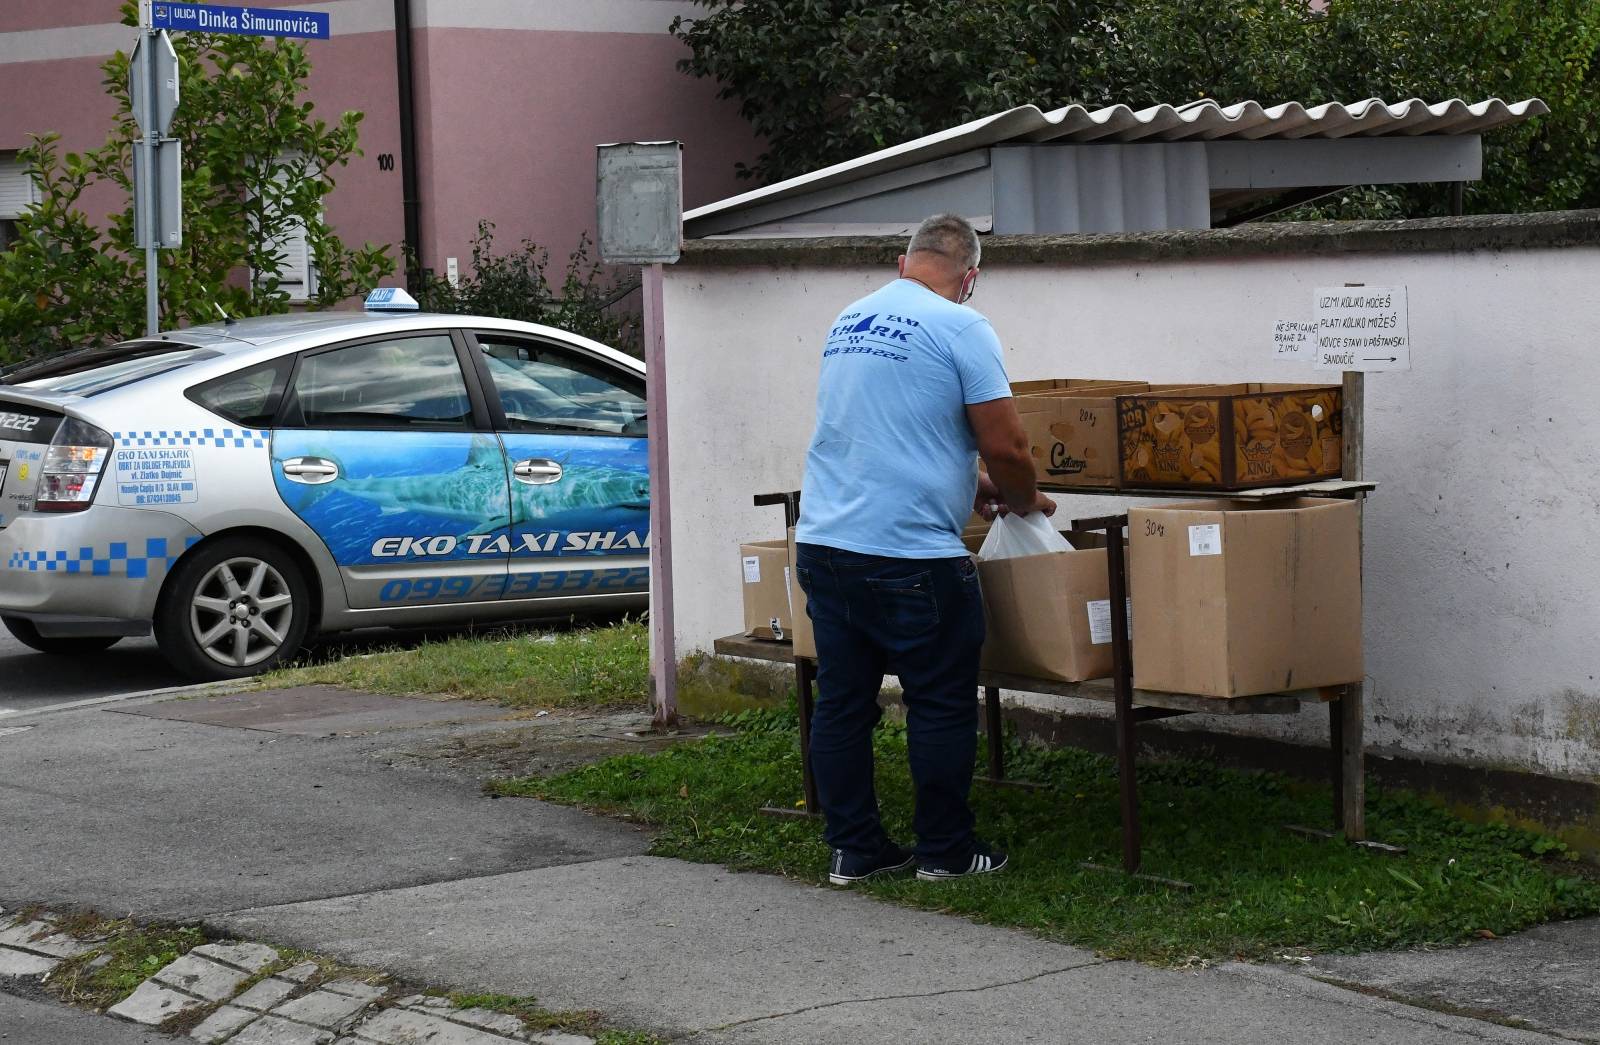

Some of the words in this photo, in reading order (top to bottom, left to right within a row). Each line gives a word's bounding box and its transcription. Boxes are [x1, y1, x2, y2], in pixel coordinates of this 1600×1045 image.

[174, 7, 197, 20] ULICA
[199, 9, 238, 29] Dinka
[241, 8, 319, 34] Šimunovića
[377, 153, 395, 171] 100
[369, 288, 390, 301] TAXI
[1319, 296, 1340, 308] UZMI
[1341, 296, 1364, 308] KOLIKO
[886, 314, 919, 327] TAXI
[1320, 318, 1341, 328] PLATI
[1342, 316, 1366, 328] KOLIKO
[1367, 312, 1397, 328] MOŽEŠ
[1297, 333, 1306, 342] ZA
[1319, 336, 1341, 348] NOVCE
[1343, 337, 1362, 348] STAVI
[1363, 338, 1368, 347] U
[1368, 334, 1406, 348] POŠTANSKI
[1278, 344, 1299, 352] ZIMU
[117, 451, 135, 460] EKO
[137, 450, 157, 460] TAXI
[159, 449, 190, 459] SHARK
[133, 461, 141, 470] ZA
[1247, 461, 1273, 475] KING
[140, 471, 159, 479] Zlatko
[371, 535, 457, 557] EKO
[466, 531, 560, 555] TAXI
